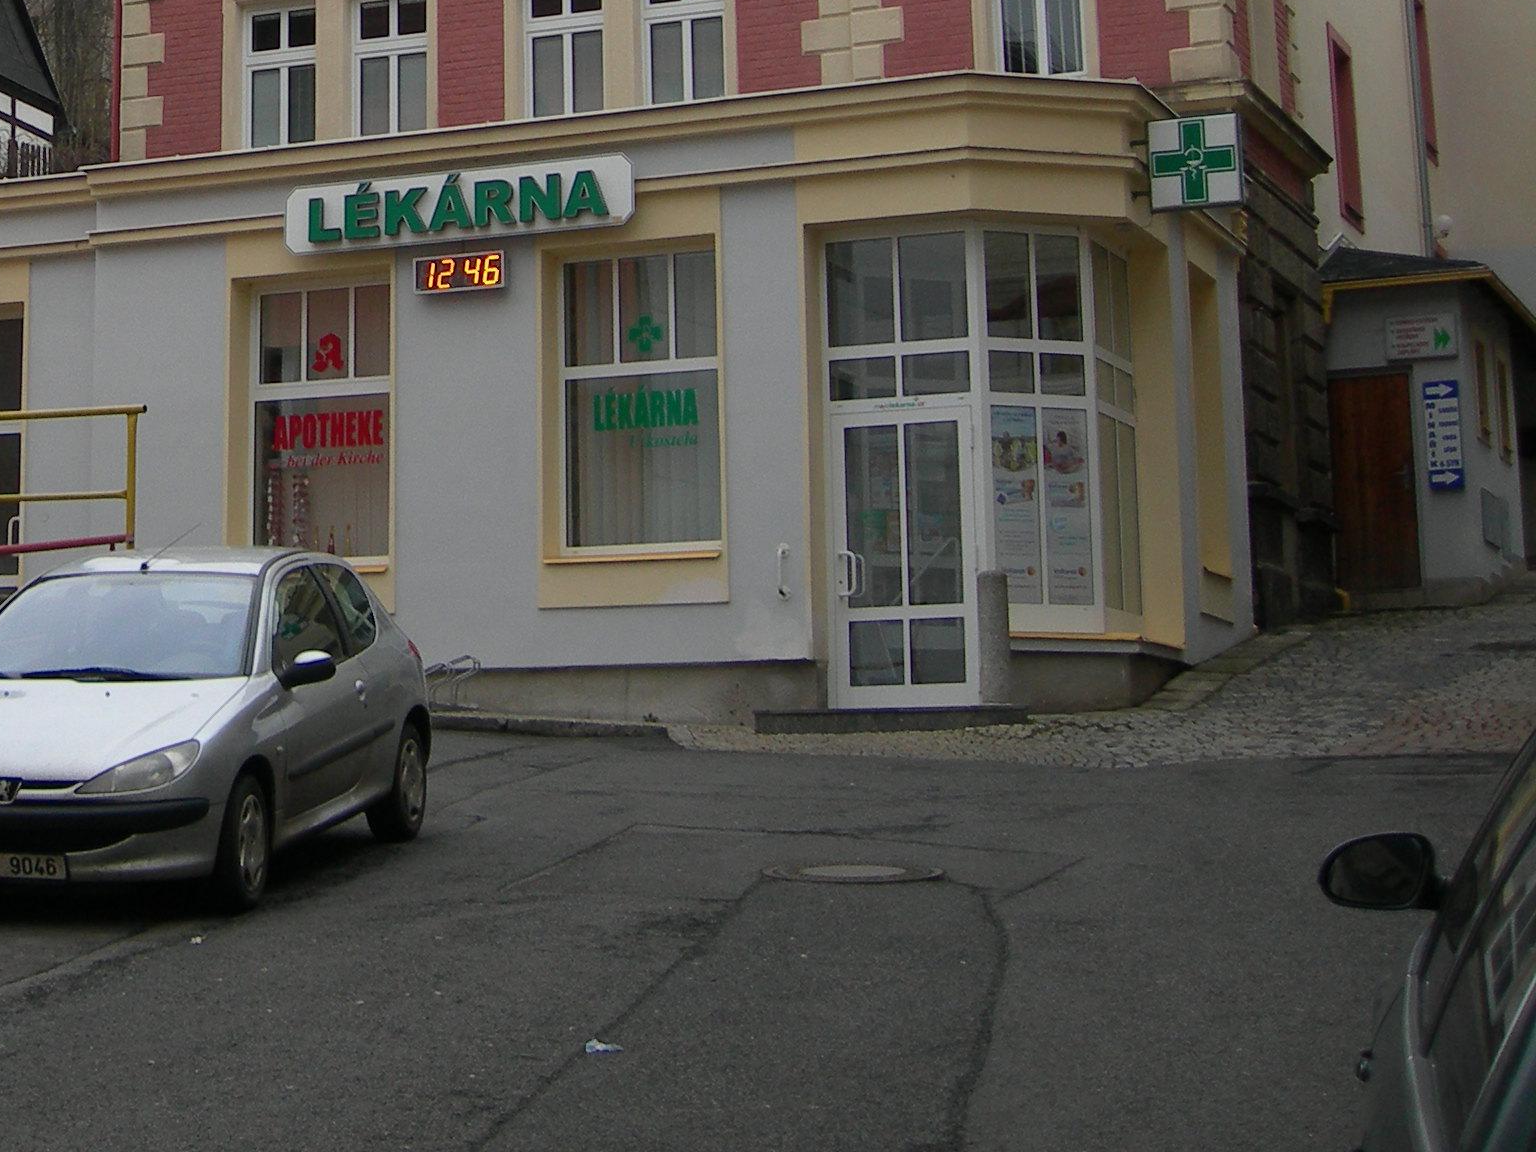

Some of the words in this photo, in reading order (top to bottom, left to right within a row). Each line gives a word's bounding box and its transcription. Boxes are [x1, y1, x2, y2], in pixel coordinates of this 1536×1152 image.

[308, 169, 609, 243] LÉKÁRNA
[273, 410, 384, 450] APOTHEKE
[593, 385, 699, 432] LÉKÁRNA
[9, 856, 57, 876] 9046
